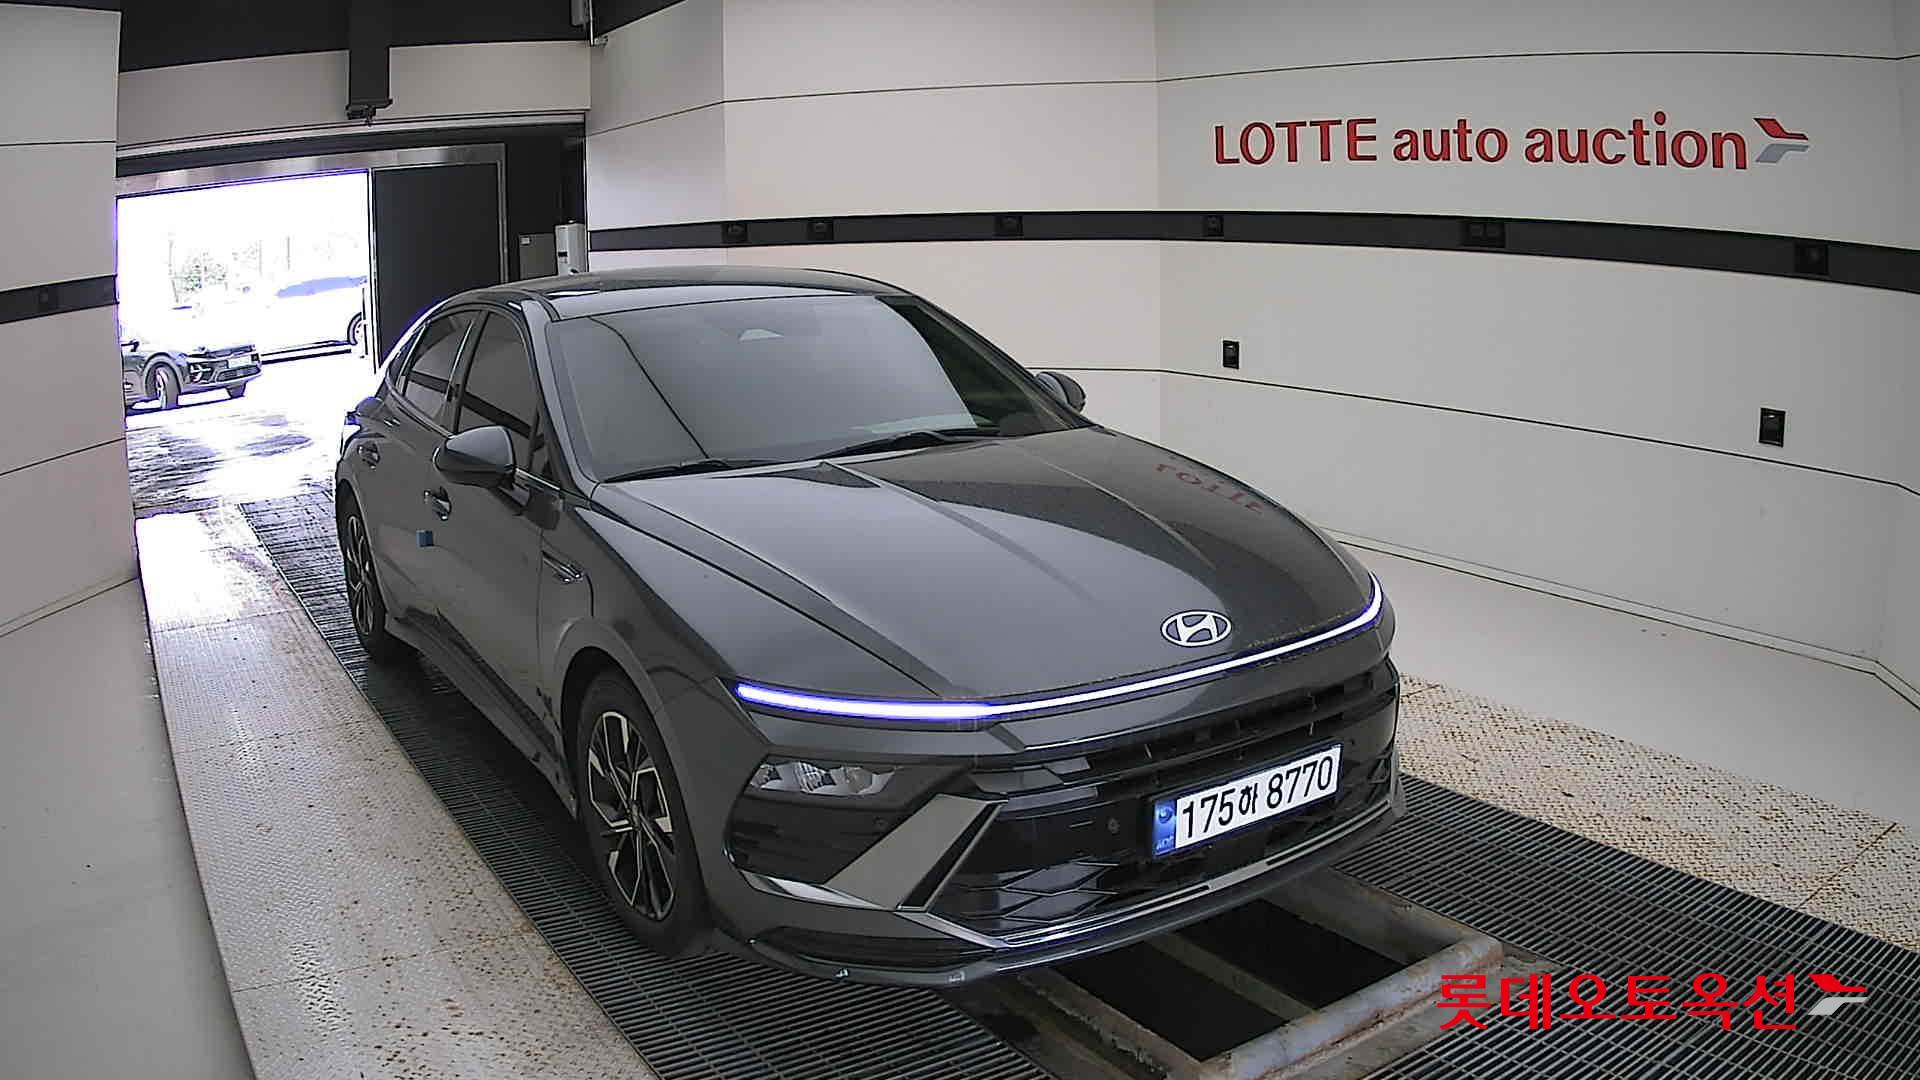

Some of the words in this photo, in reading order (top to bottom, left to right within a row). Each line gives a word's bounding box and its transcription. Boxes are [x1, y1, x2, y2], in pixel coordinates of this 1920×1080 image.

[1214, 118, 1377, 165] LOTTE
[1393, 119, 1509, 163] auto
[1524, 111, 1748, 170] auction
[1182, 783, 1259, 838] 175하
[1266, 755, 1334, 810] 8770
